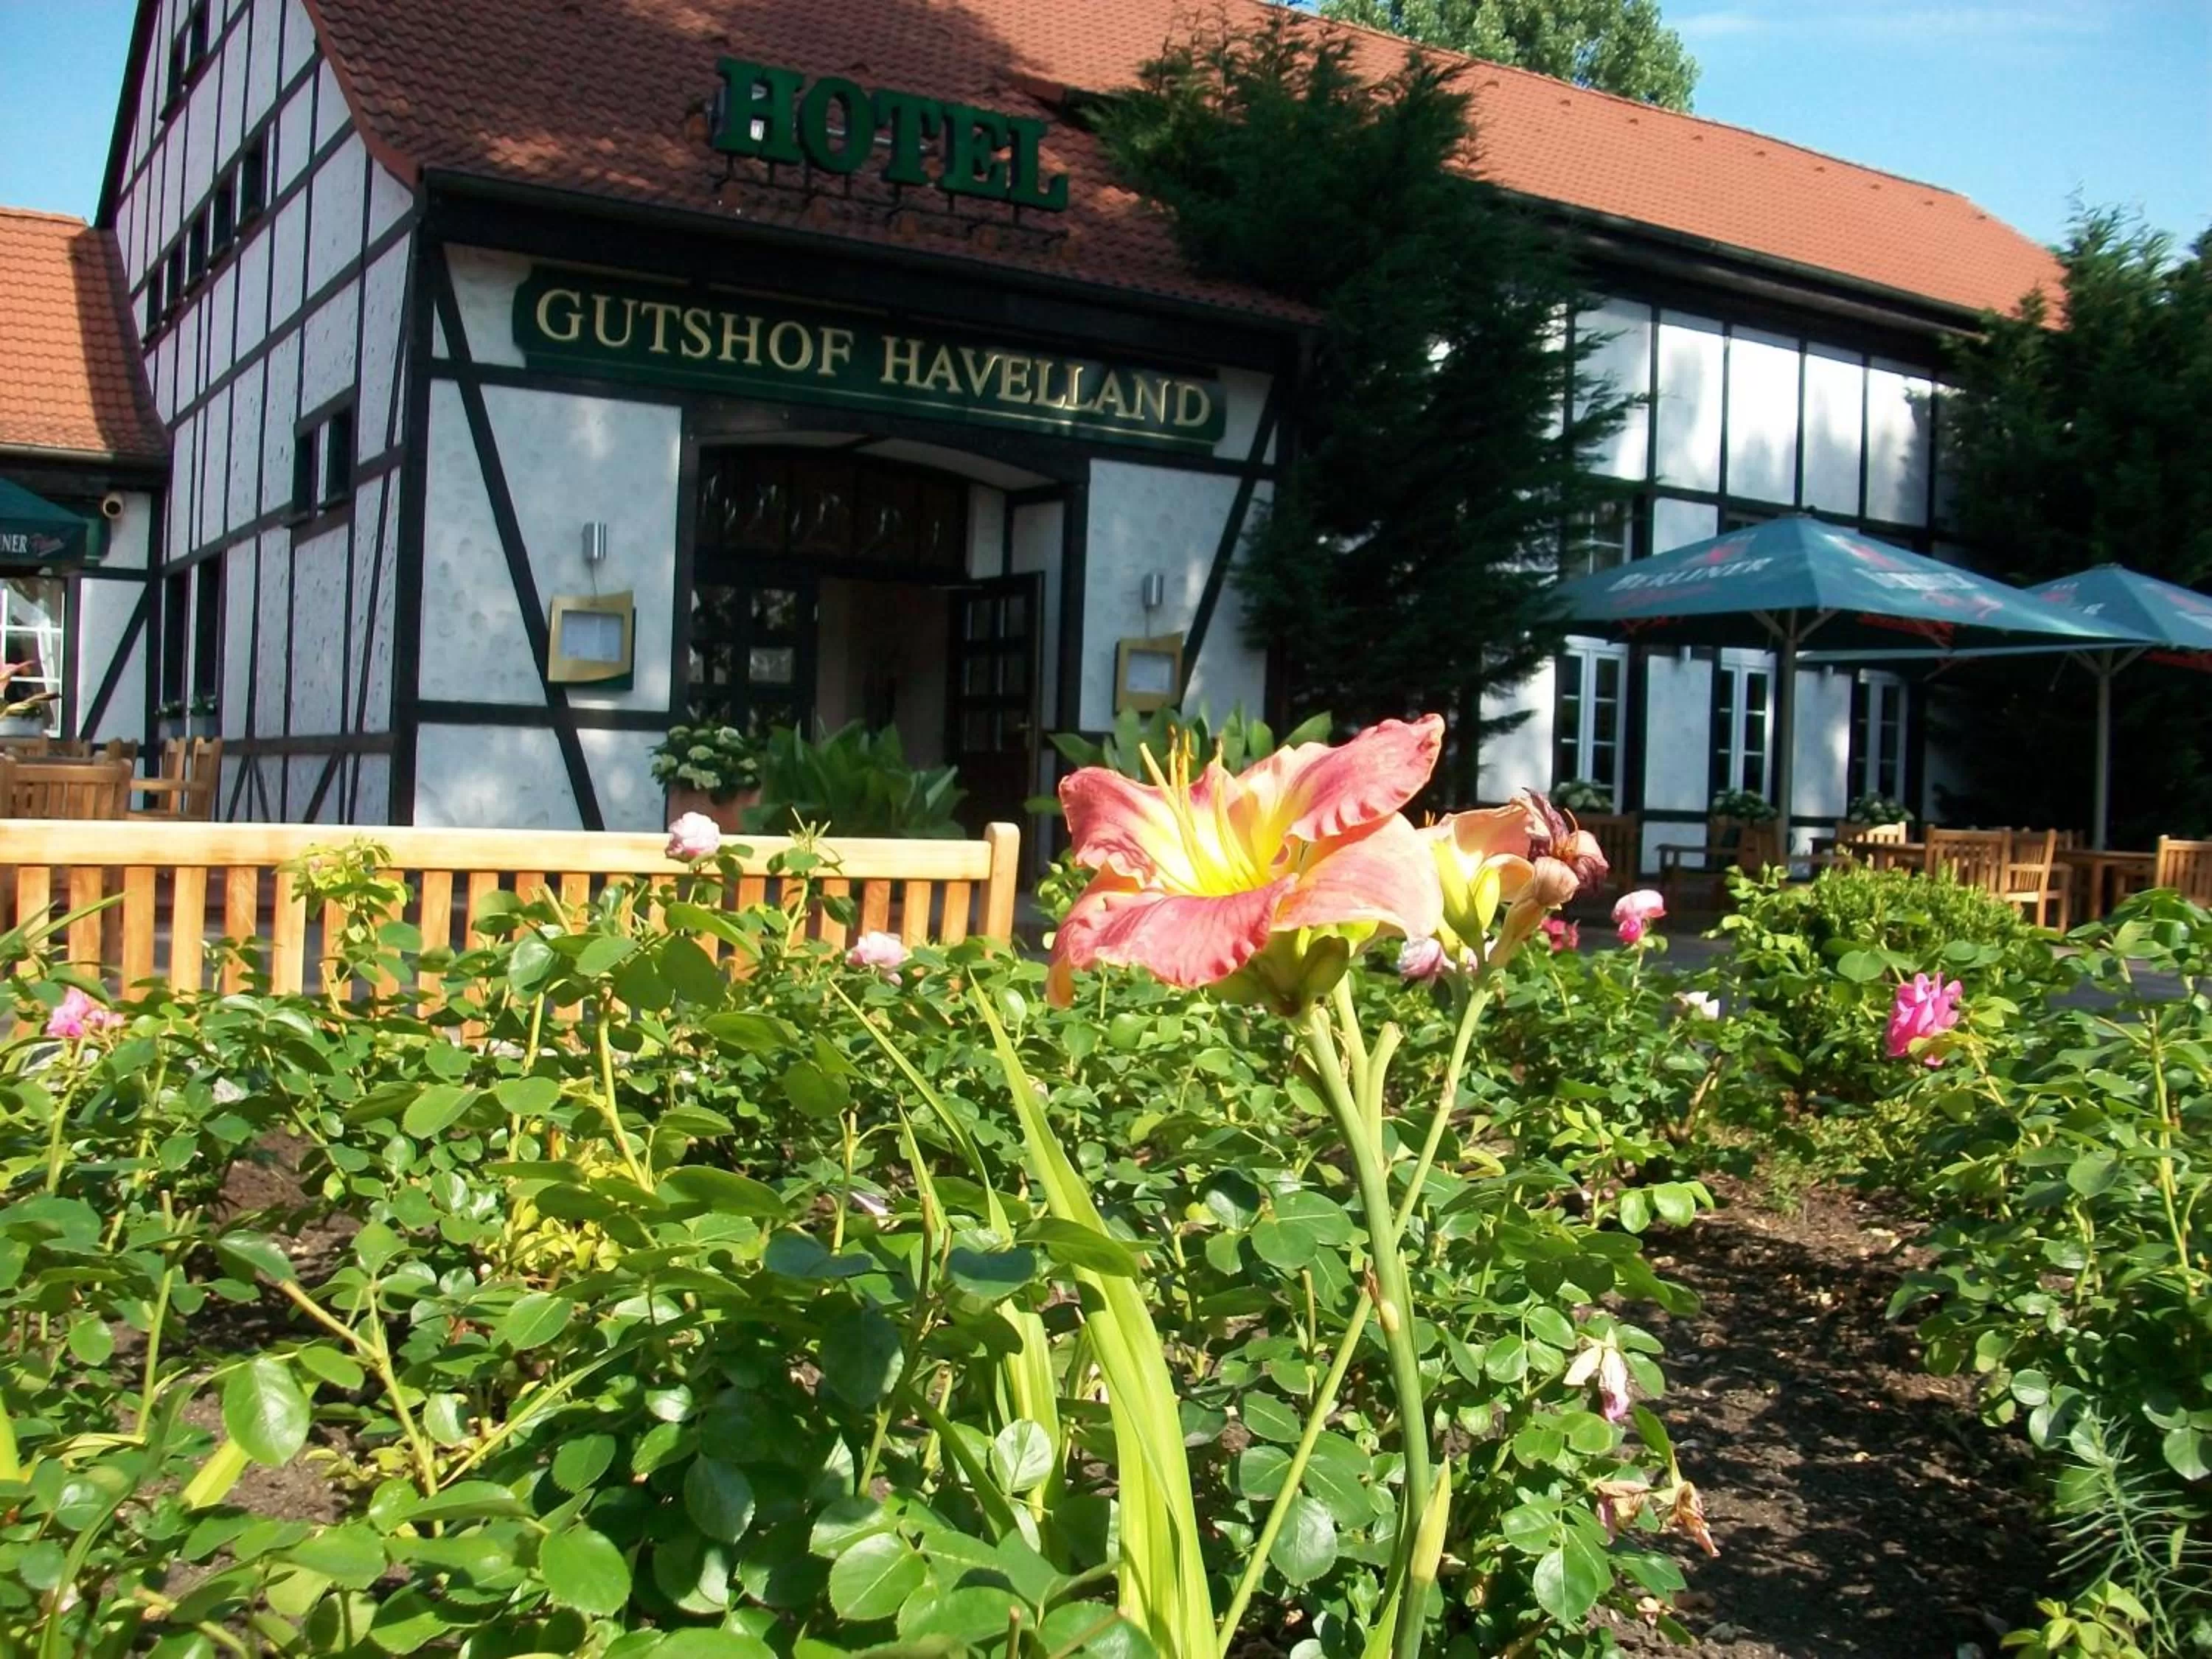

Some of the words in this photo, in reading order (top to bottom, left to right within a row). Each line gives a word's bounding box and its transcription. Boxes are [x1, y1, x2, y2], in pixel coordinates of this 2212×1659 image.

[711, 56, 1069, 212] HOTEL
[536, 288, 854, 376] GUTSHOF
[880, 335, 1211, 428] HAVELLAND
